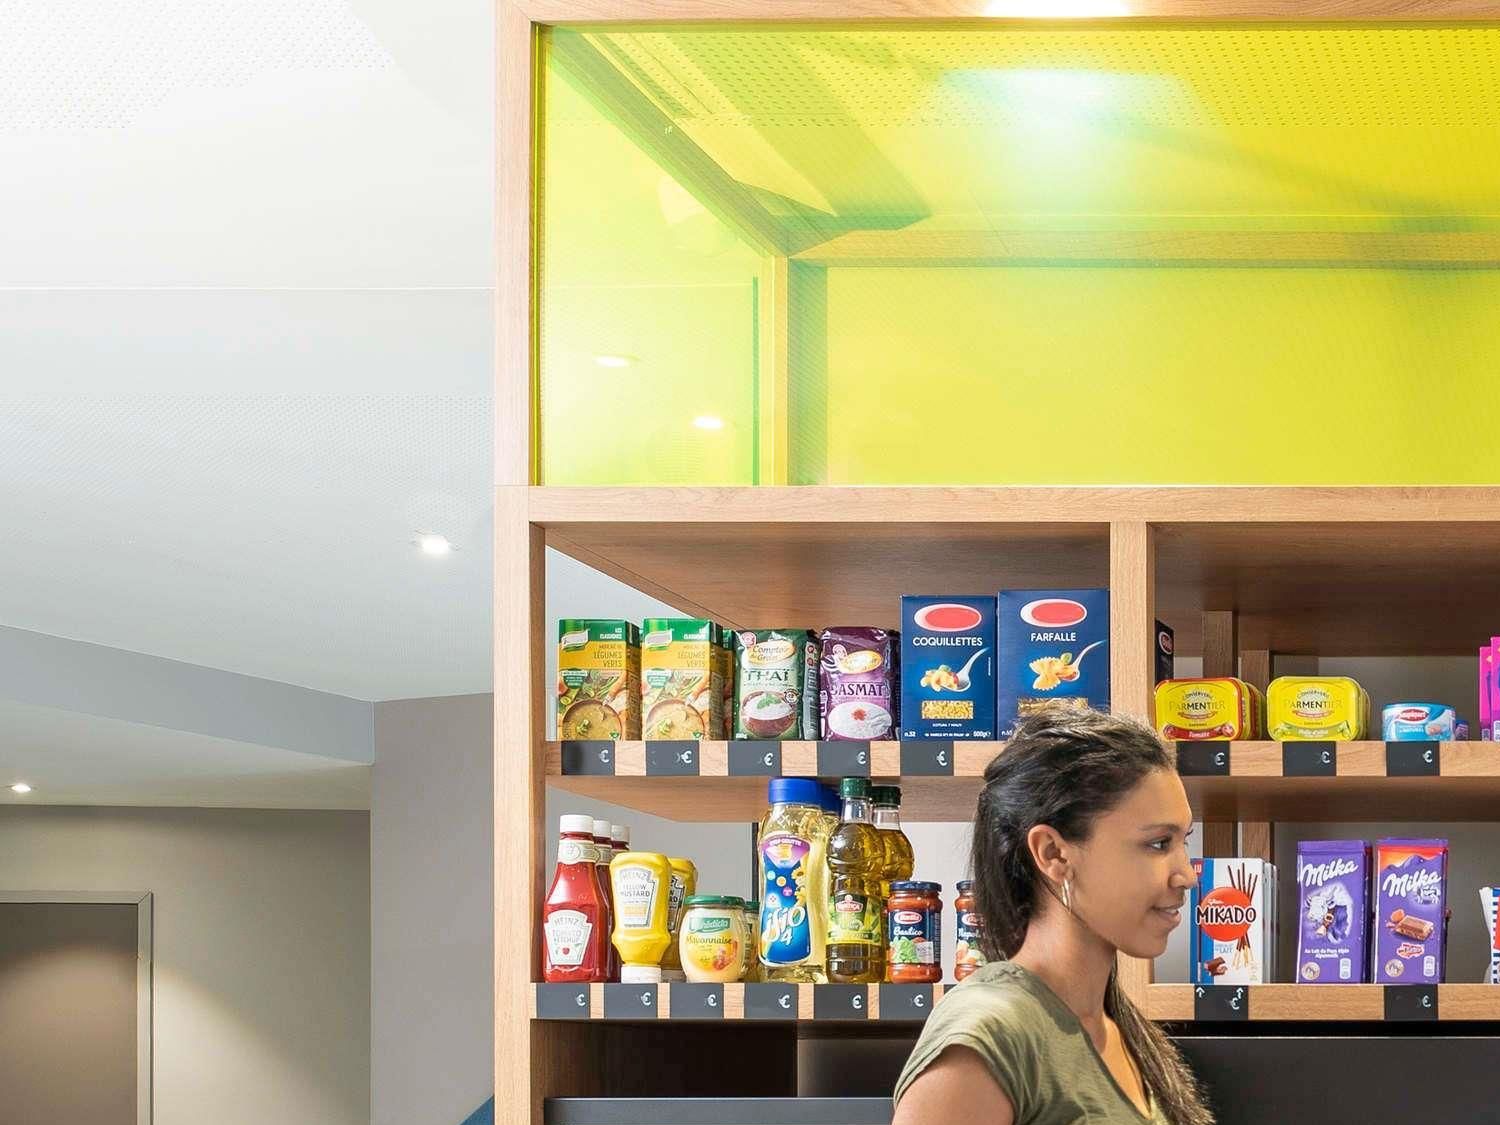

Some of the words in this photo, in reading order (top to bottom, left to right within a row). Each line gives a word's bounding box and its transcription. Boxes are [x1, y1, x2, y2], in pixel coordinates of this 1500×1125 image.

[912, 636, 983, 647] COQUILLETTES
[1030, 632, 1077, 642] FARFALLE
[830, 683, 888, 697] BASMAT
[1300, 858, 1359, 887] Milka
[1382, 868, 1441, 898] Milka
[1196, 905, 1257, 925] MIKADO
